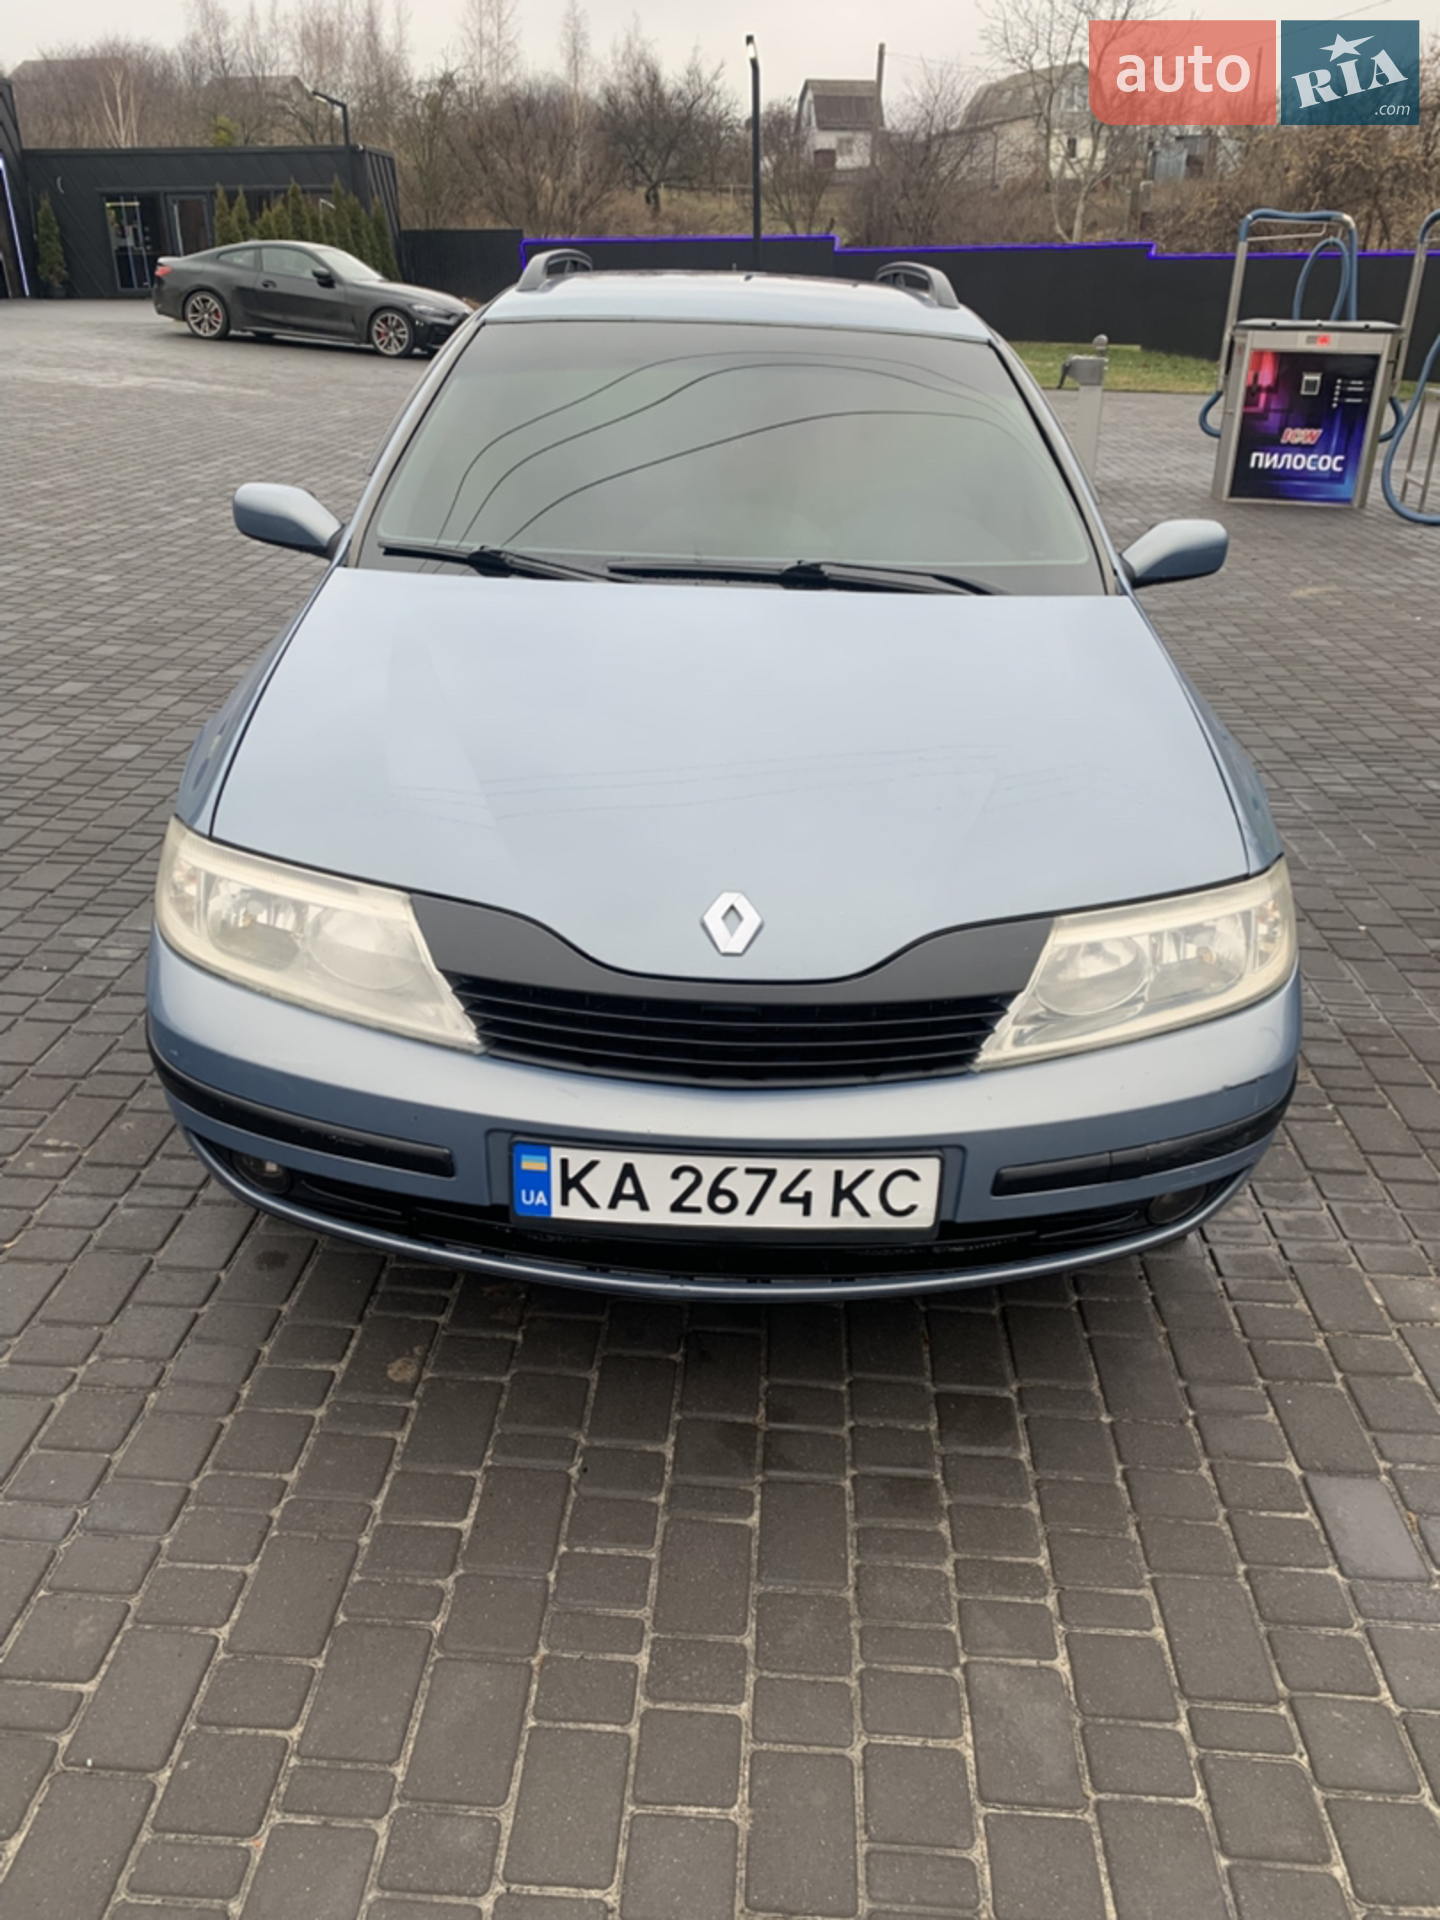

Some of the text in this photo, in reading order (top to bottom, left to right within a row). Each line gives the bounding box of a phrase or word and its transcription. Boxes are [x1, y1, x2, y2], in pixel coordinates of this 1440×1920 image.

[1250, 451, 1345, 472] ПИЛОСОС
[520, 1189, 548, 1207] UA
[559, 1157, 922, 1219] KA 2674 KC
